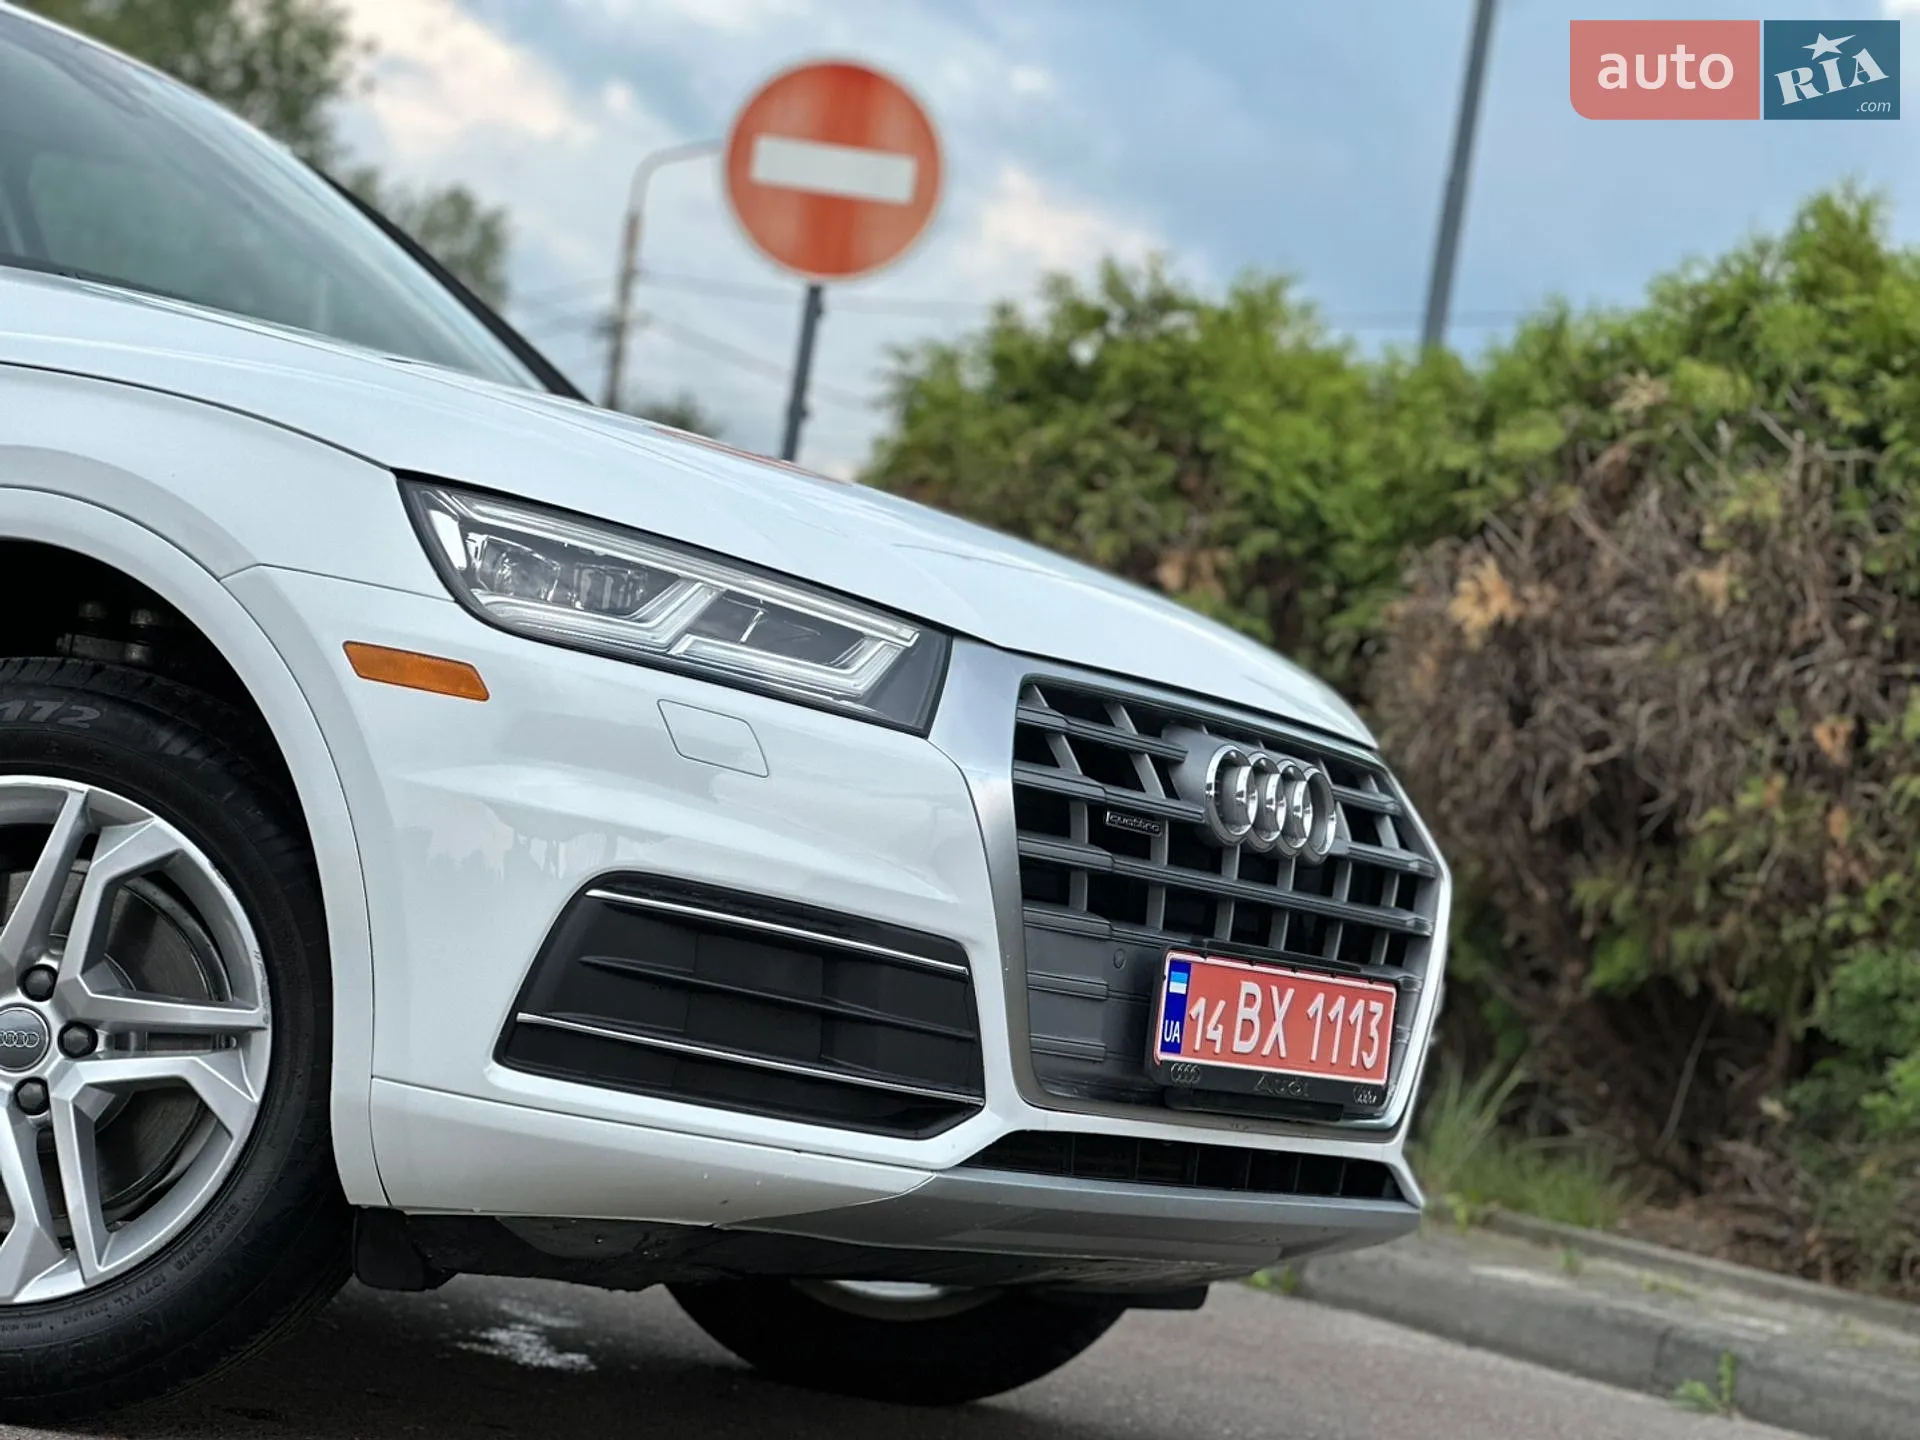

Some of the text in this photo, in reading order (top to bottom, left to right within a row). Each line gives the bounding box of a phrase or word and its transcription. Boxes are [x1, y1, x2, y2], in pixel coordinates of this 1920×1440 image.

[1164, 1019, 1181, 1044] UA
[1189, 980, 1385, 1070] 14 BX 1113
